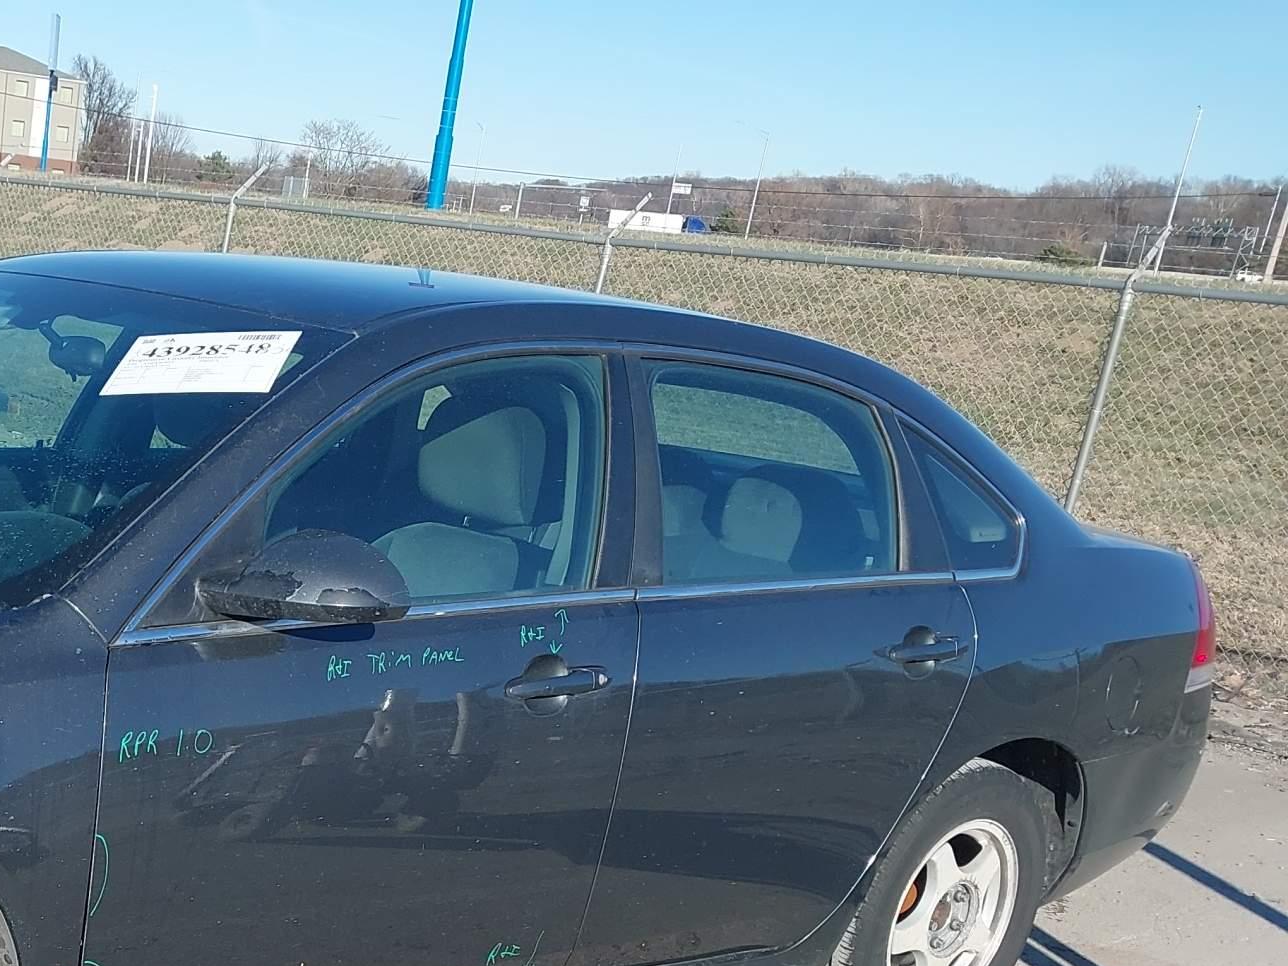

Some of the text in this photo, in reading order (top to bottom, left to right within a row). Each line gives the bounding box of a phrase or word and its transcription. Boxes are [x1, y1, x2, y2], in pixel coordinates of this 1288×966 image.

[140, 342, 271, 357] 43928548
[119, 729, 213, 763] RPR 1.0
